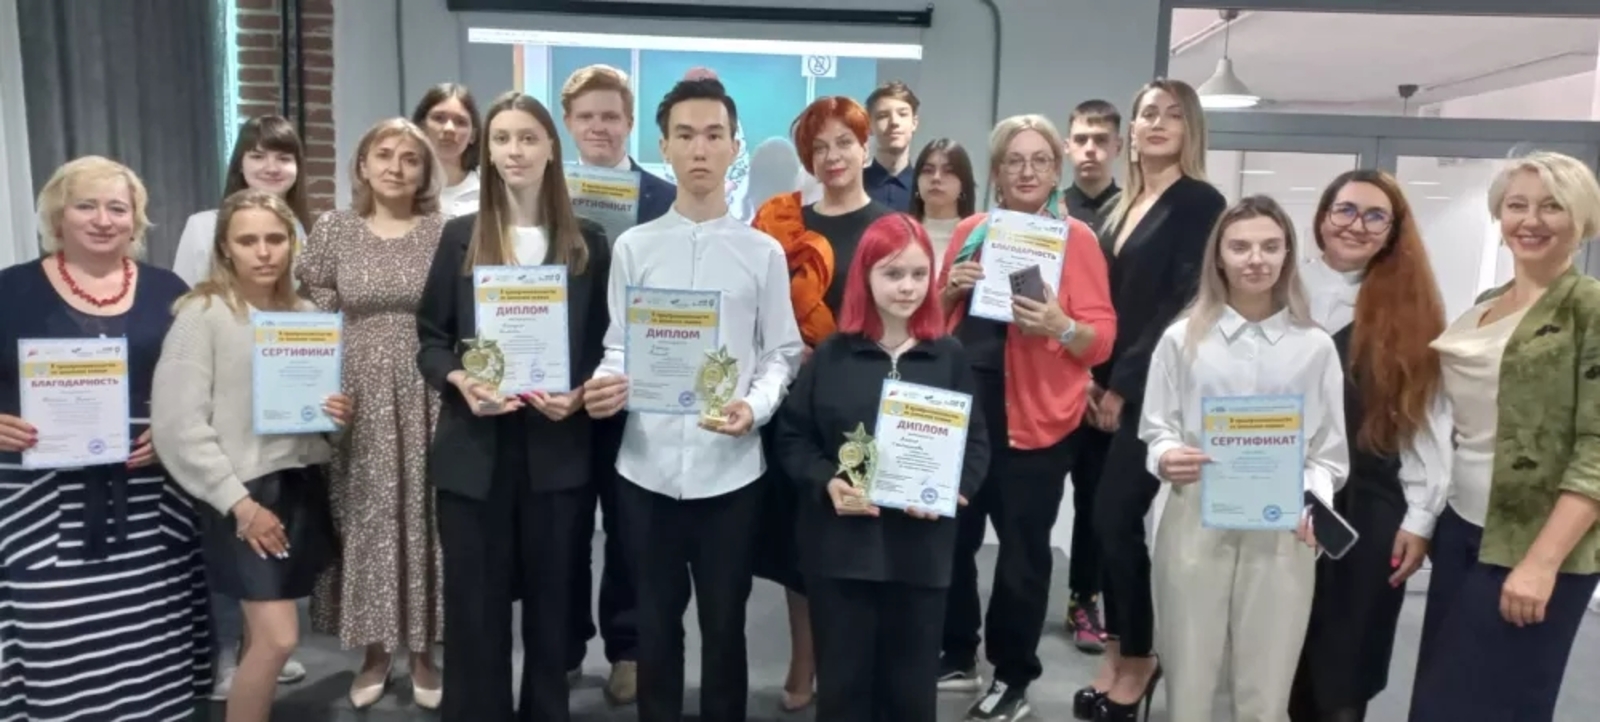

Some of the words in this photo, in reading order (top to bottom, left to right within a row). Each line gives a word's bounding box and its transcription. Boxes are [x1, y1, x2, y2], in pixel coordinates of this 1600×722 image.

[572, 198, 632, 212] ЕРТИФИКАТ
[496, 305, 549, 317] ДИПЛОМ
[646, 327, 700, 340] ДИПЛОМ
[262, 347, 335, 357] СЕРТИФИКАТ
[31, 378, 119, 388] БЛАГОДАРНОСТЬ
[897, 420, 949, 436] ДИПЛОМ
[1210, 436, 1297, 446] СЕРТИФИКАТ
